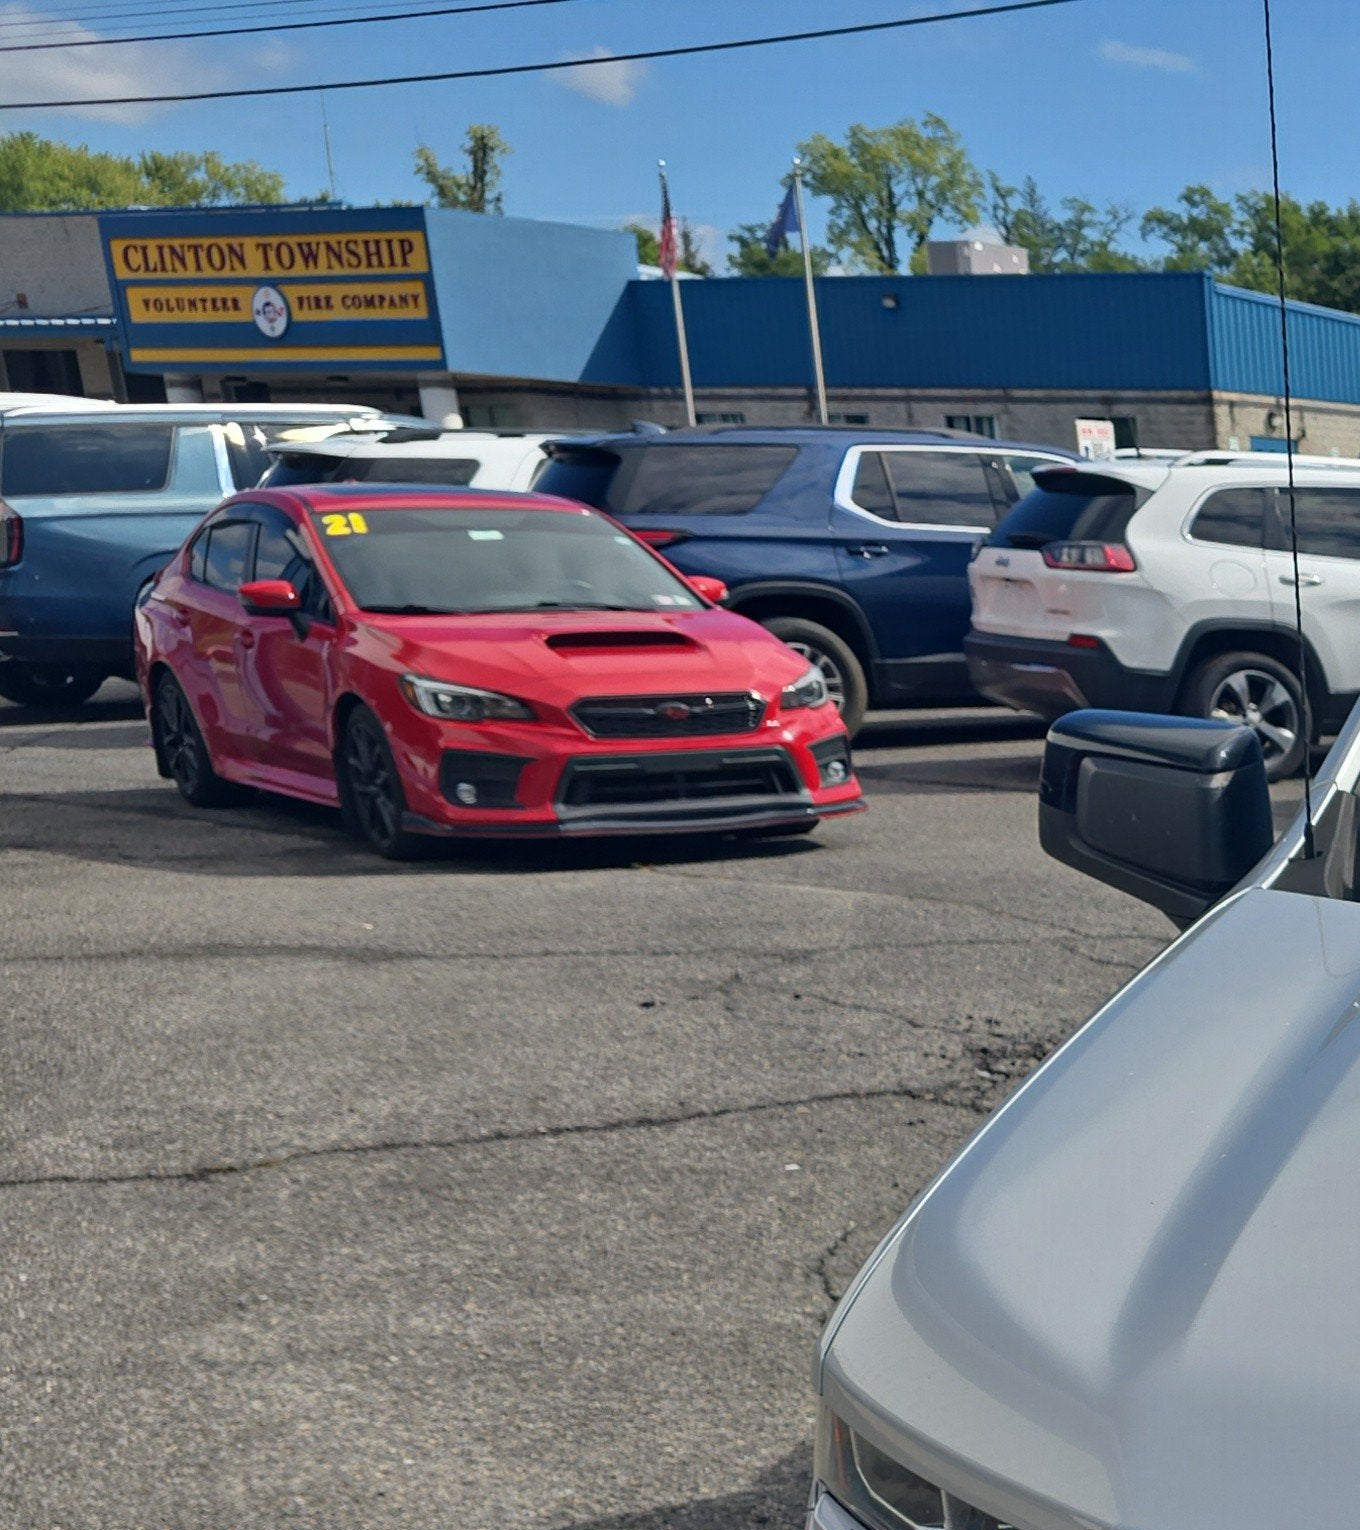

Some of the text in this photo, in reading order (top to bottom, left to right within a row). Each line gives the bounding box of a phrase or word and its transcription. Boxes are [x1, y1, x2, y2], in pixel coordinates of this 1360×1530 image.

[123, 238, 415, 274] CLINTON TOWNSHIP
[142, 292, 421, 313] VOLUNTEER FIRE COMPANY
[321, 512, 369, 536] 21
